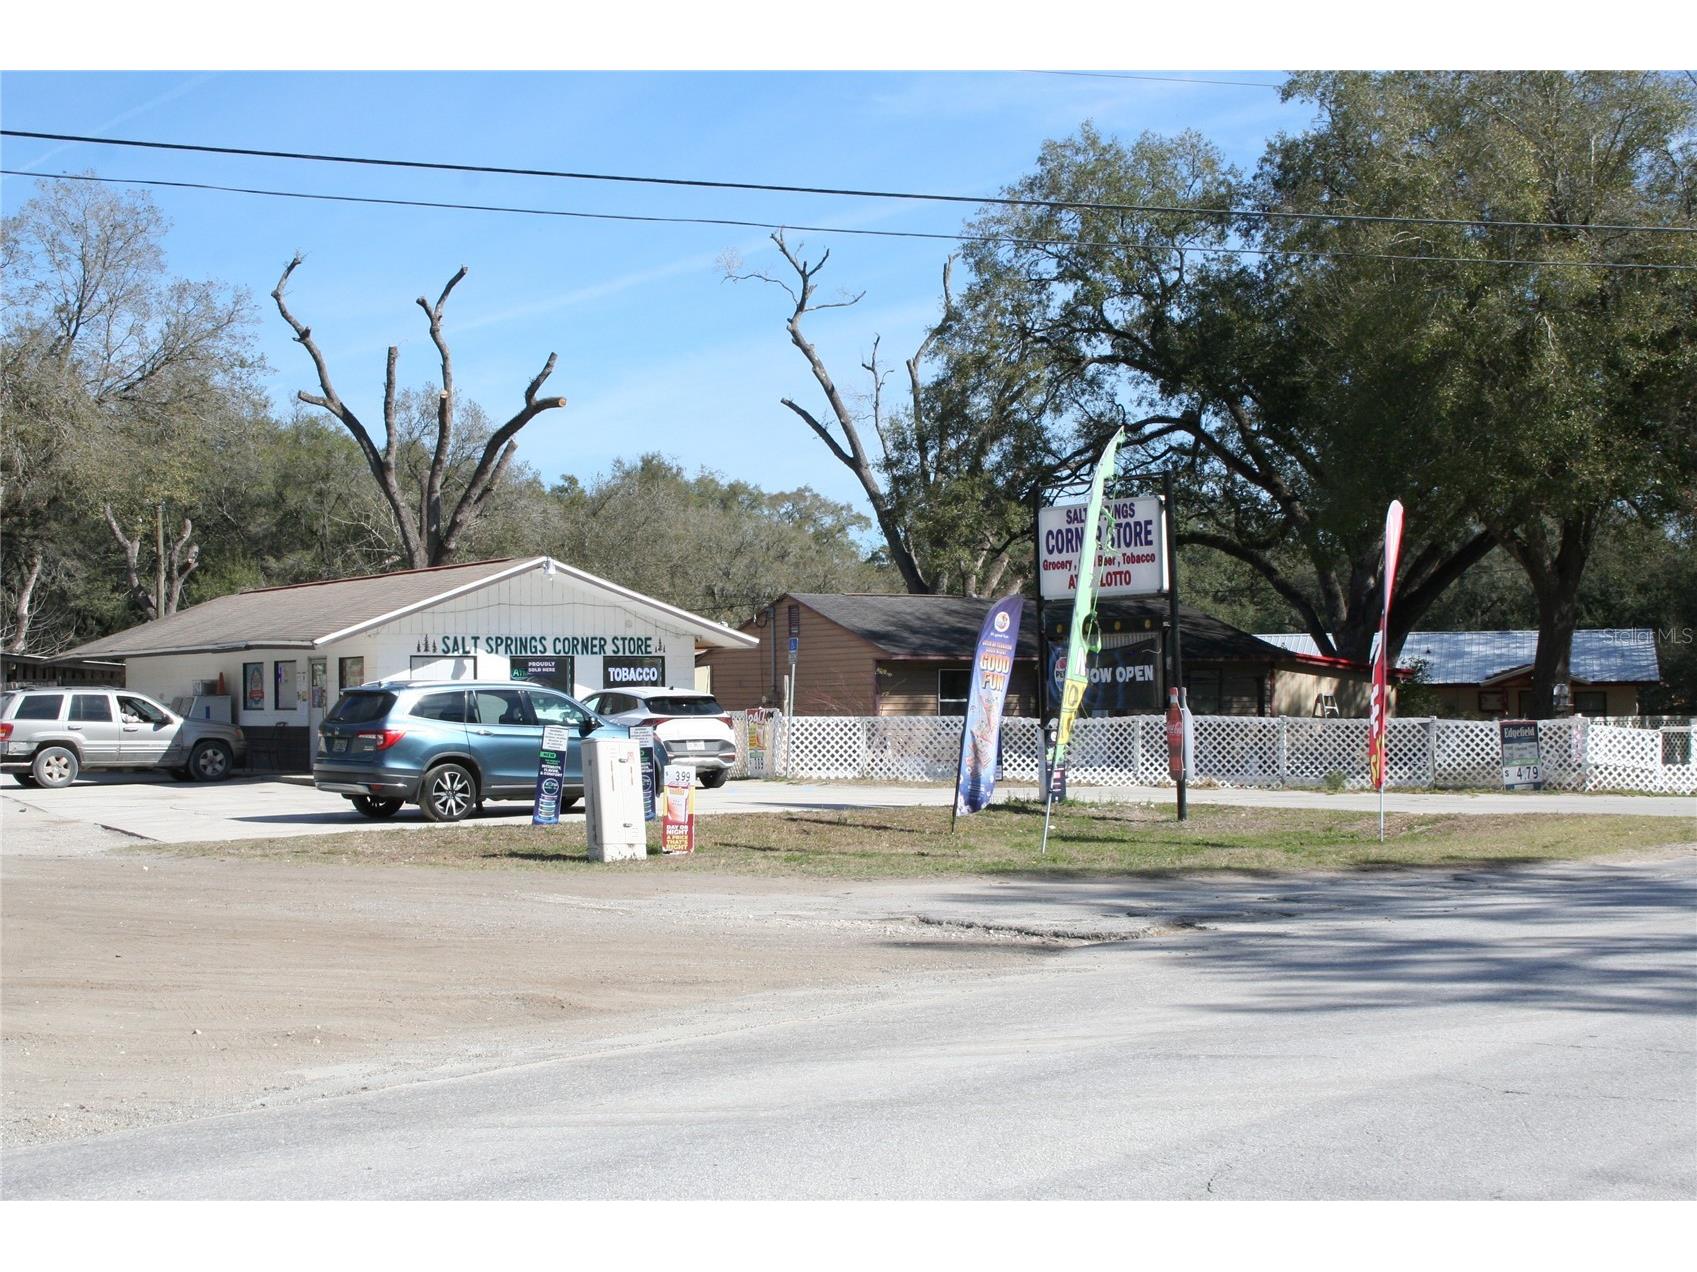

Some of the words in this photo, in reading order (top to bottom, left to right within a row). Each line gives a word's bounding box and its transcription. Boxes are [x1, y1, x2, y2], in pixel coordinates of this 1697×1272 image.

[1122, 552, 1156, 565] Tobacco
[1100, 570, 1131, 588] LOTTO
[441, 635, 481, 655] SALT
[485, 636, 547, 655] SPRINGS
[553, 636, 607, 655] CORNER
[611, 636, 653, 655] STORE
[980, 653, 1010, 674] GOOD
[608, 667, 658, 682] TOBACCO
[982, 671, 1005, 691] FUN
[1116, 665, 1154, 682] OPEN
